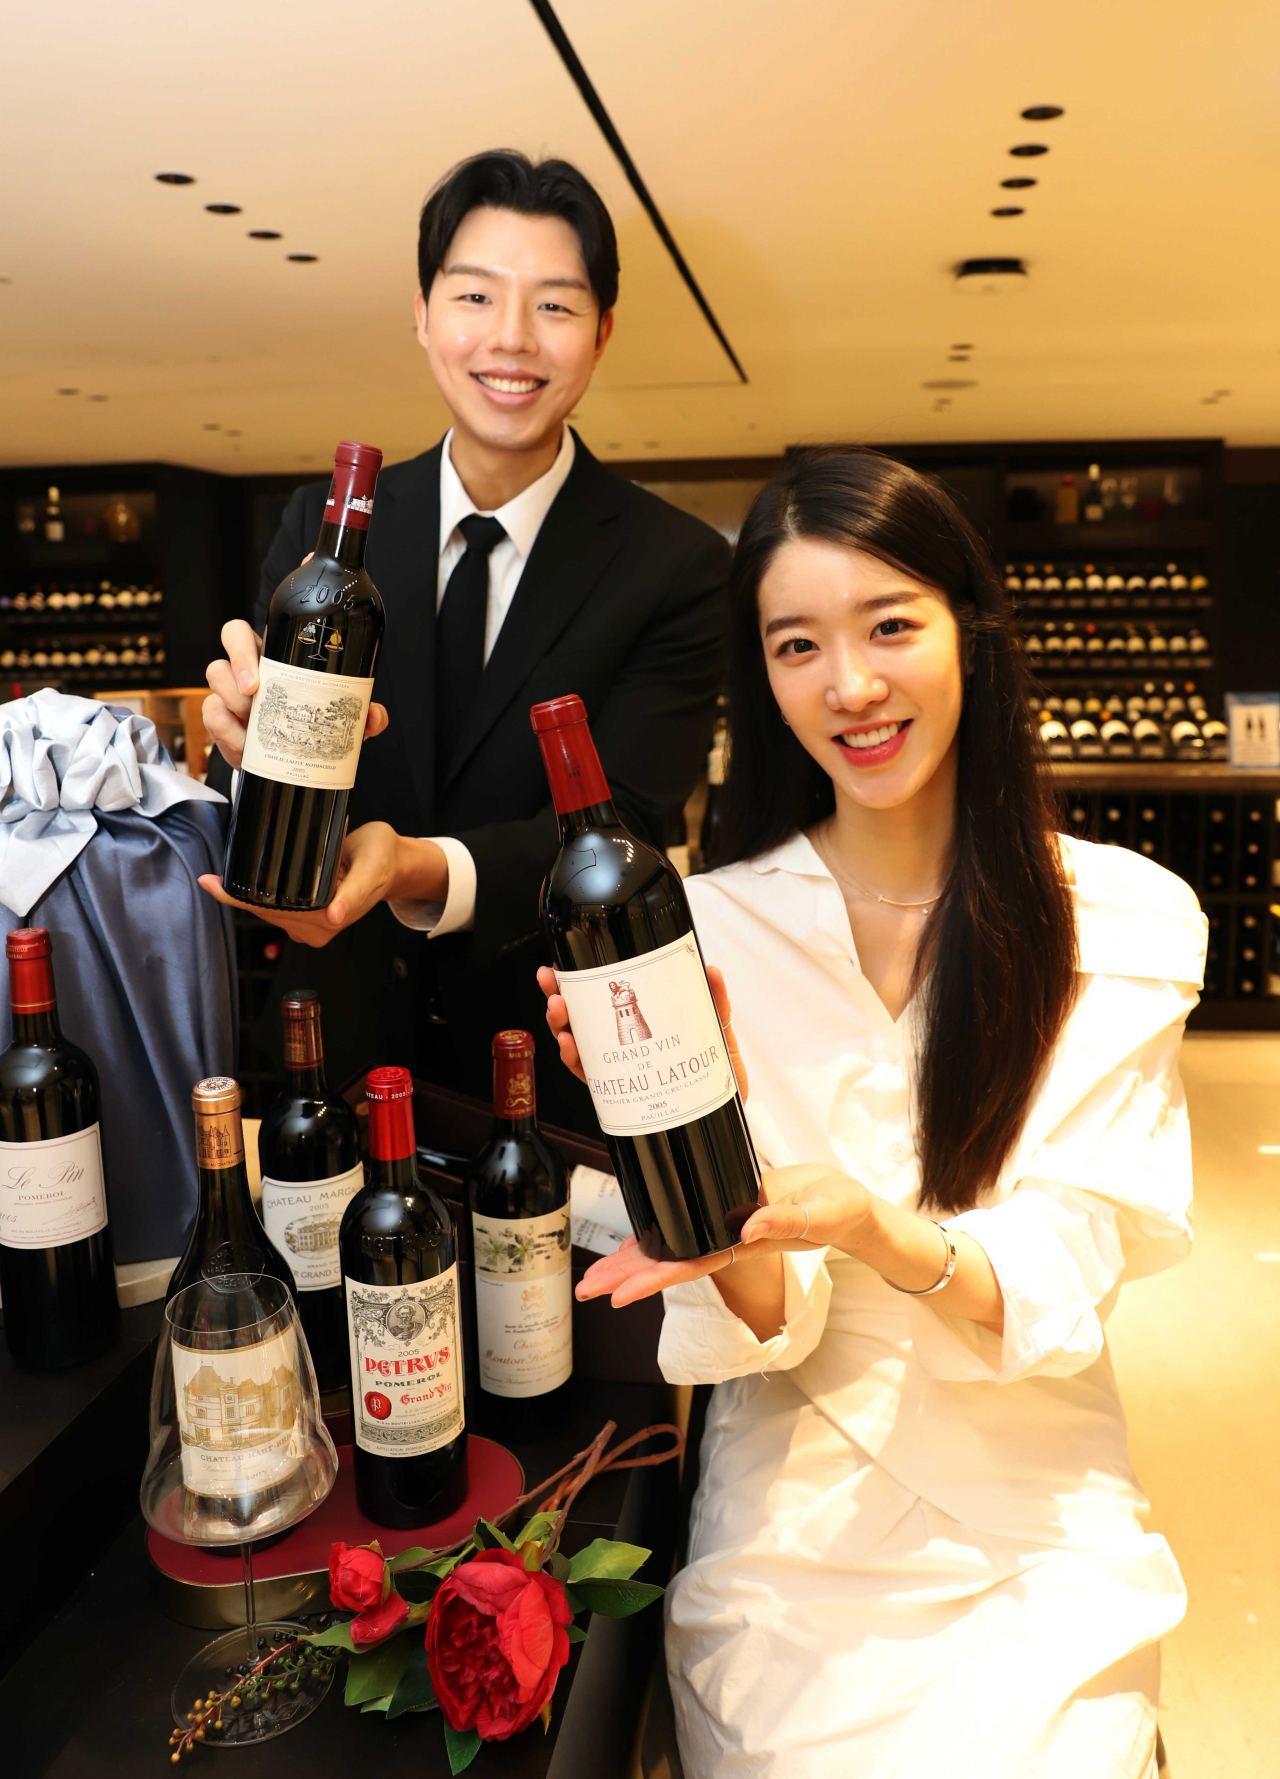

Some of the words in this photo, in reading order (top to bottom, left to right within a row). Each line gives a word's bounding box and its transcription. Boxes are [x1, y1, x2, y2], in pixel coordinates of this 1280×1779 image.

[603, 1045, 650, 1064] GRAND
[655, 1034, 681, 1052] VIN
[588, 1074, 649, 1095] CHATEAU
[657, 1045, 719, 1086] LATOUR
[637, 1061, 652, 1070] DE
[633, 1091, 662, 1103] GRAND
[665, 1084, 682, 1095] CRU
[648, 1100, 667, 1111] 2005
[641, 1106, 680, 1121] PAUILLAC
[2, 1166, 36, 1190] Le
[39, 1160, 84, 1188] Pin
[18, 1191, 66, 1200] POMEROL
[309, 1203, 329, 1211] 2005
[301, 1270, 331, 1278] GRAND
[398, 1349, 420, 1357] 2005
[364, 1346, 450, 1377] PETRUS
[375, 1372, 442, 1387] POMEROL
[400, 1387, 434, 1405] Grand
[200, 1454, 244, 1462] CHATEAU
